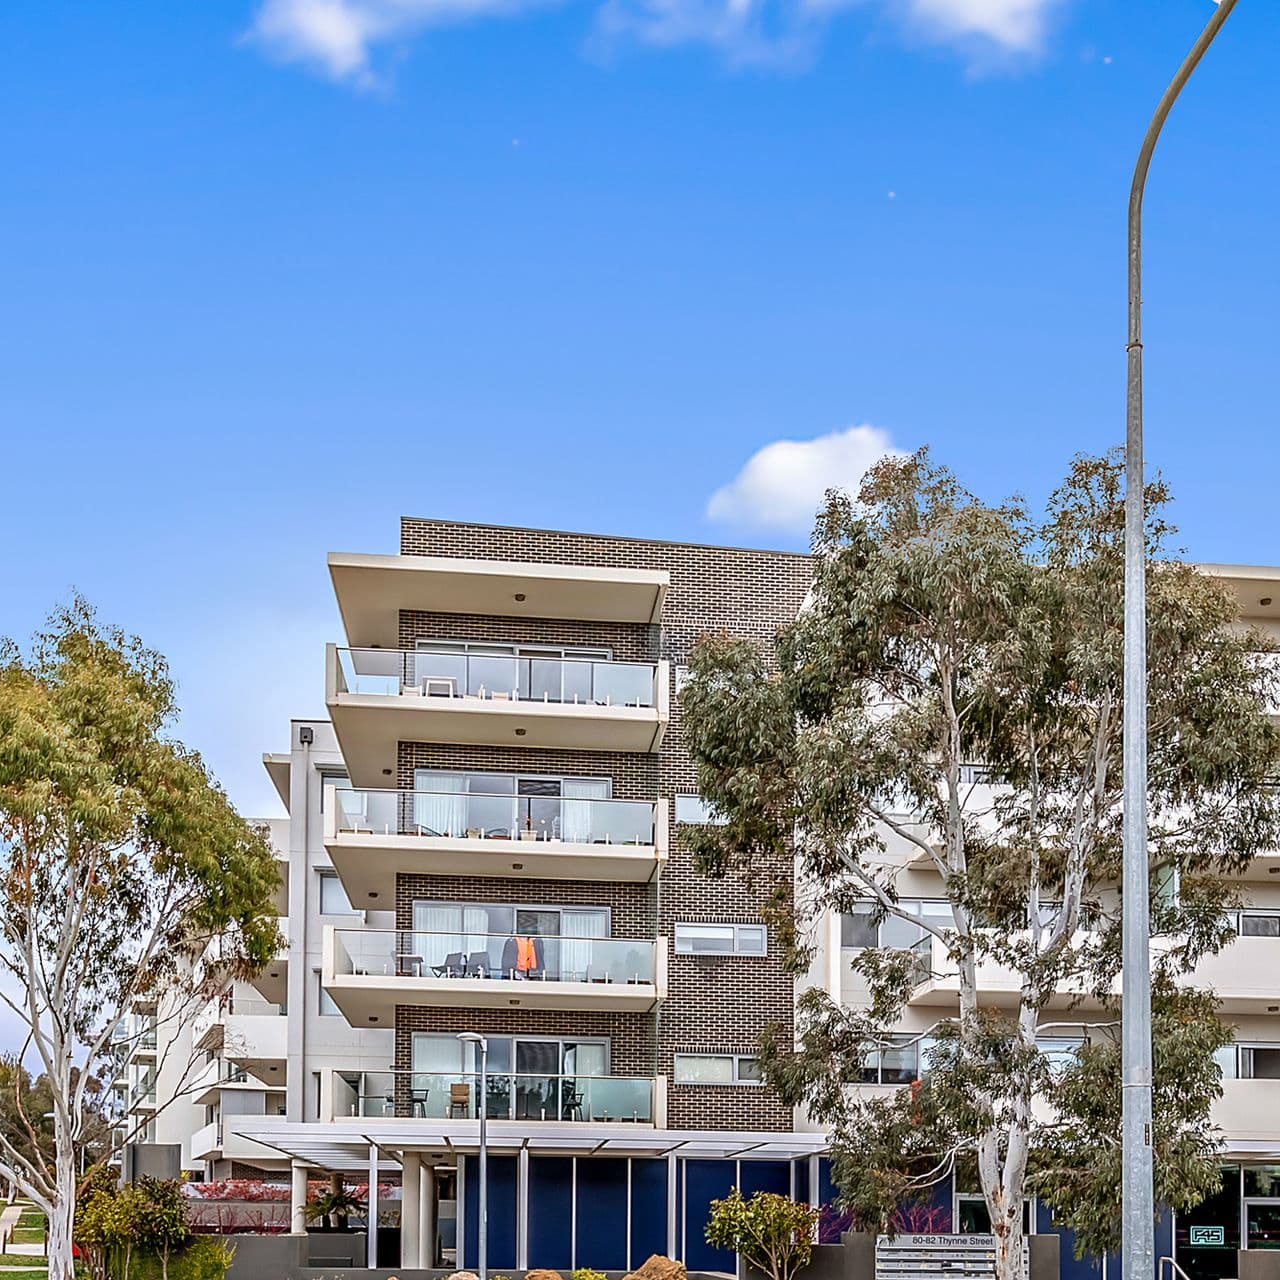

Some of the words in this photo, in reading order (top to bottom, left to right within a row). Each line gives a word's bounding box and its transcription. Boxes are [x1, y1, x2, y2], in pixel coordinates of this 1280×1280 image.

[938, 1236, 967, 1246] Thynne
[969, 1237, 993, 1245] Street
[1193, 1229, 1221, 1242] F45
